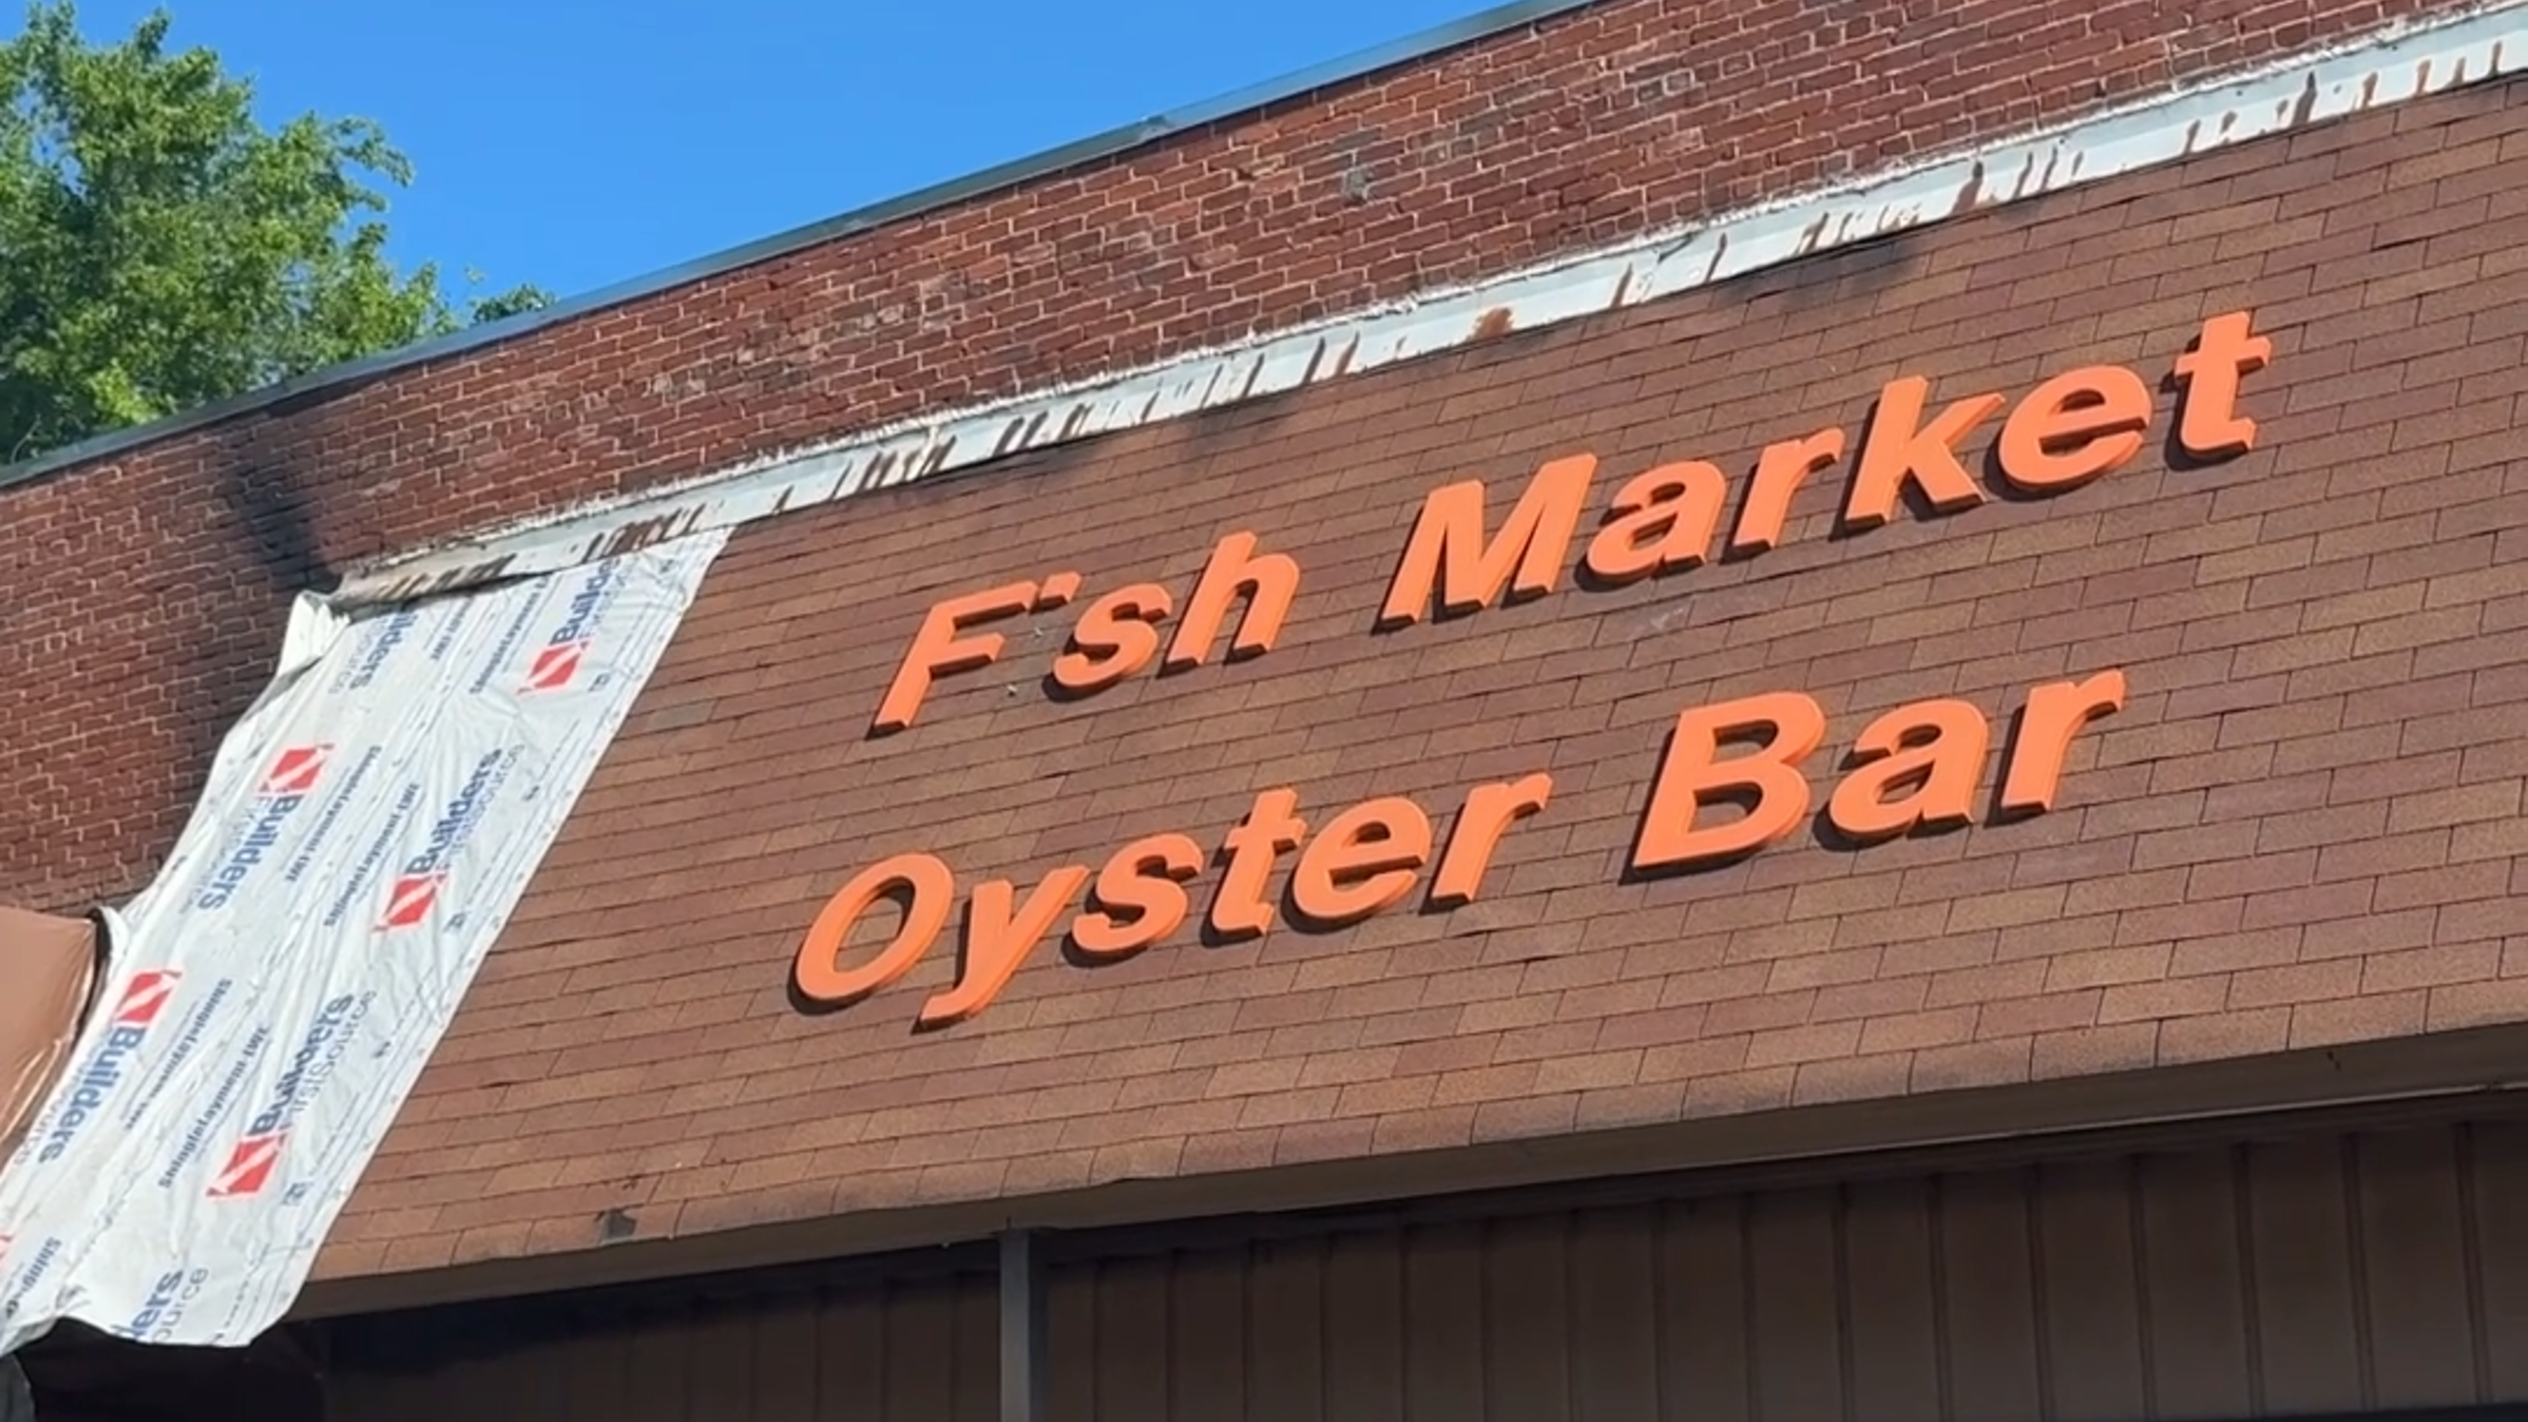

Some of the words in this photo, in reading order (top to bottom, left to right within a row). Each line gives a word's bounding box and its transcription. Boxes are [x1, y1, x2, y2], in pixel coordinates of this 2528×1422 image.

[873, 531, 1300, 728] Fsh
[1380, 311, 2271, 626] Market
[197, 794, 304, 911] Builders
[405, 748, 502, 874] Builders
[794, 772, 1553, 1023] Oyster
[1630, 669, 2126, 870] Bar
[38, 1026, 147, 1164] Builders
[248, 993, 355, 1136] Builders
